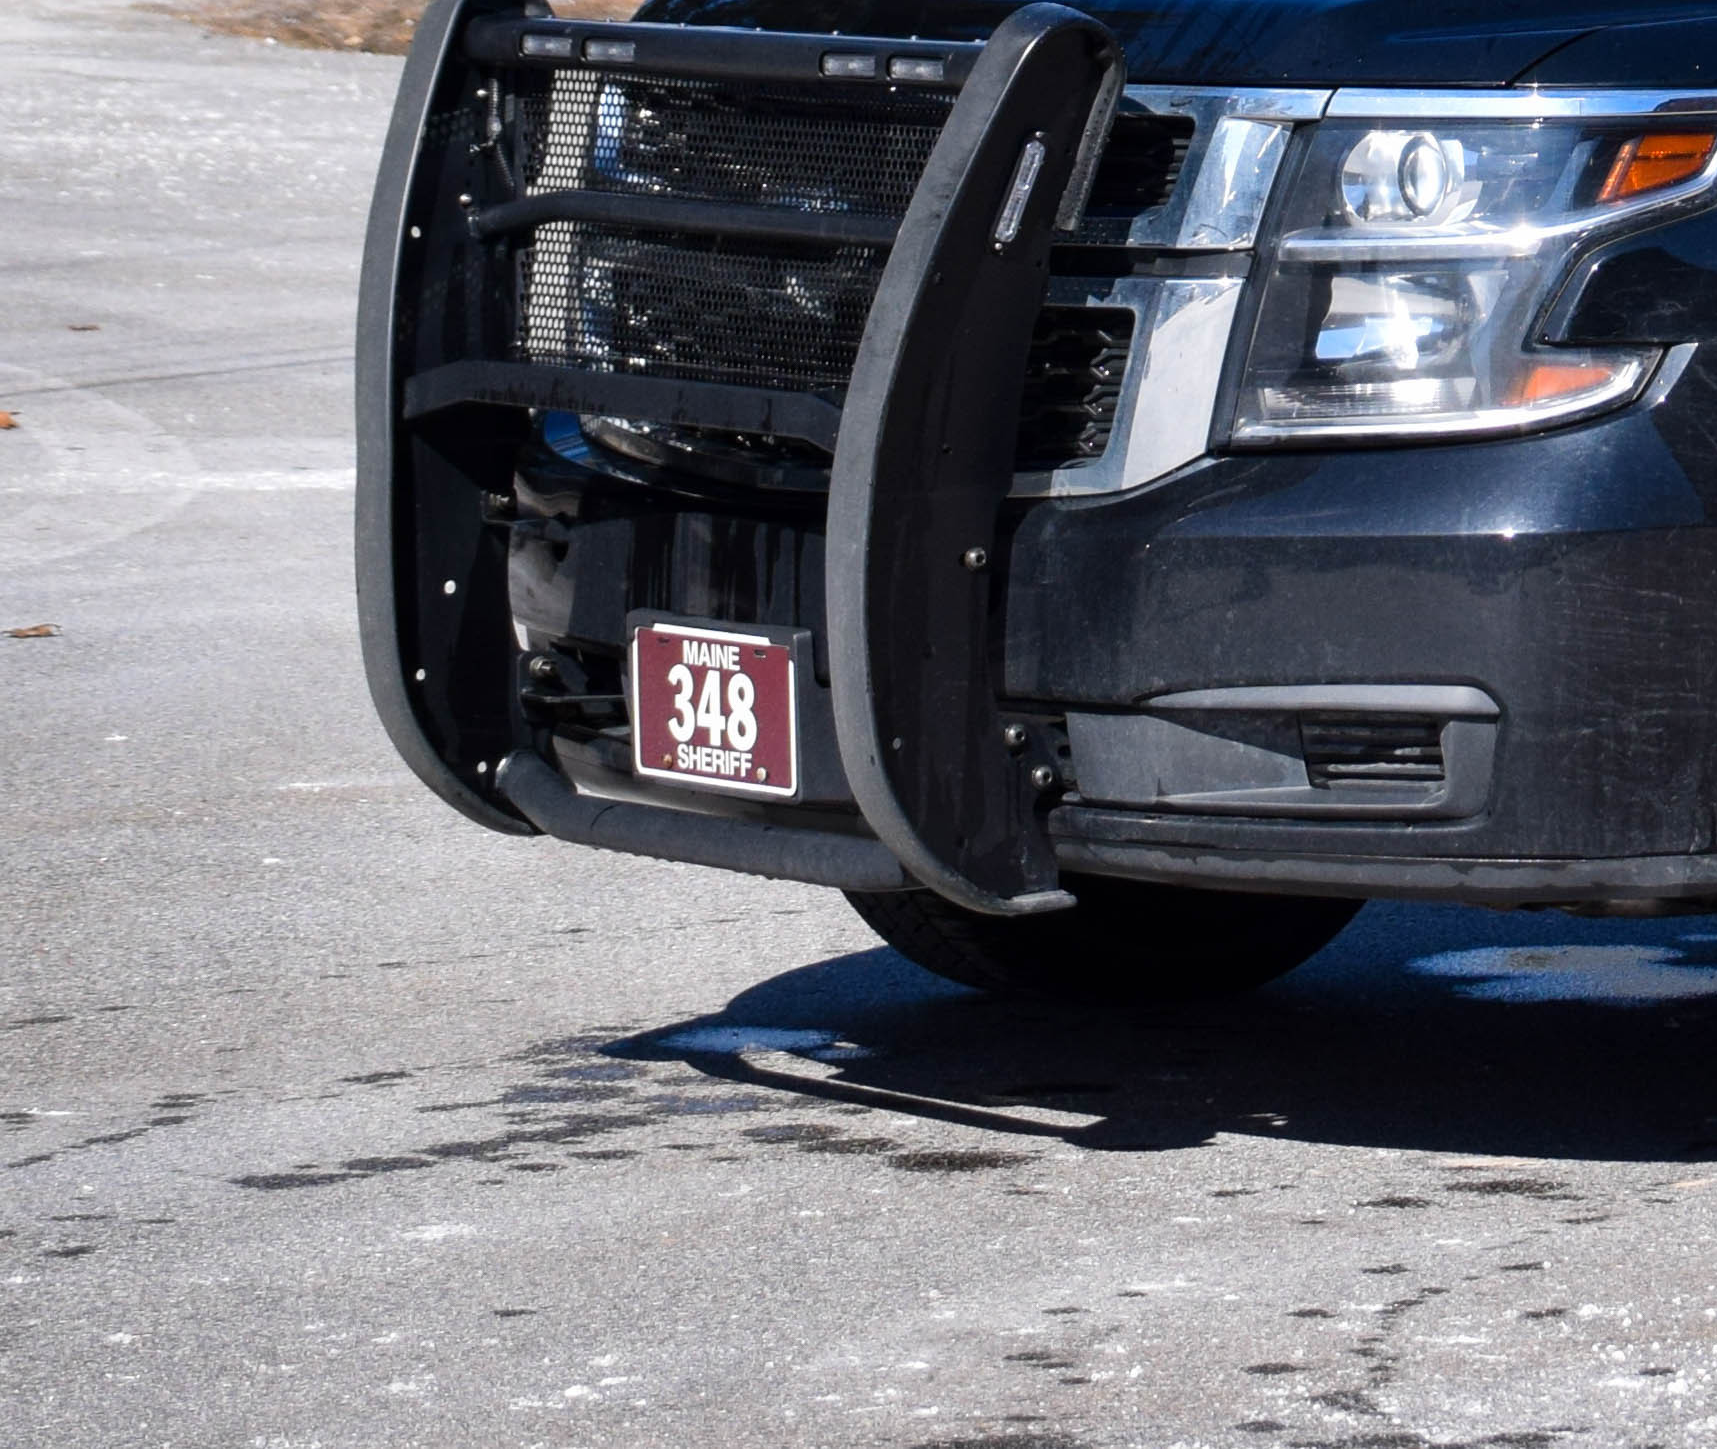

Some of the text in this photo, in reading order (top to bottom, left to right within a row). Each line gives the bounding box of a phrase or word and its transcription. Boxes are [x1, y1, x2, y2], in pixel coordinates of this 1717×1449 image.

[682, 639, 741, 671] MAINE
[667, 663, 758, 752] 348
[676, 743, 753, 778] SHERIFF
